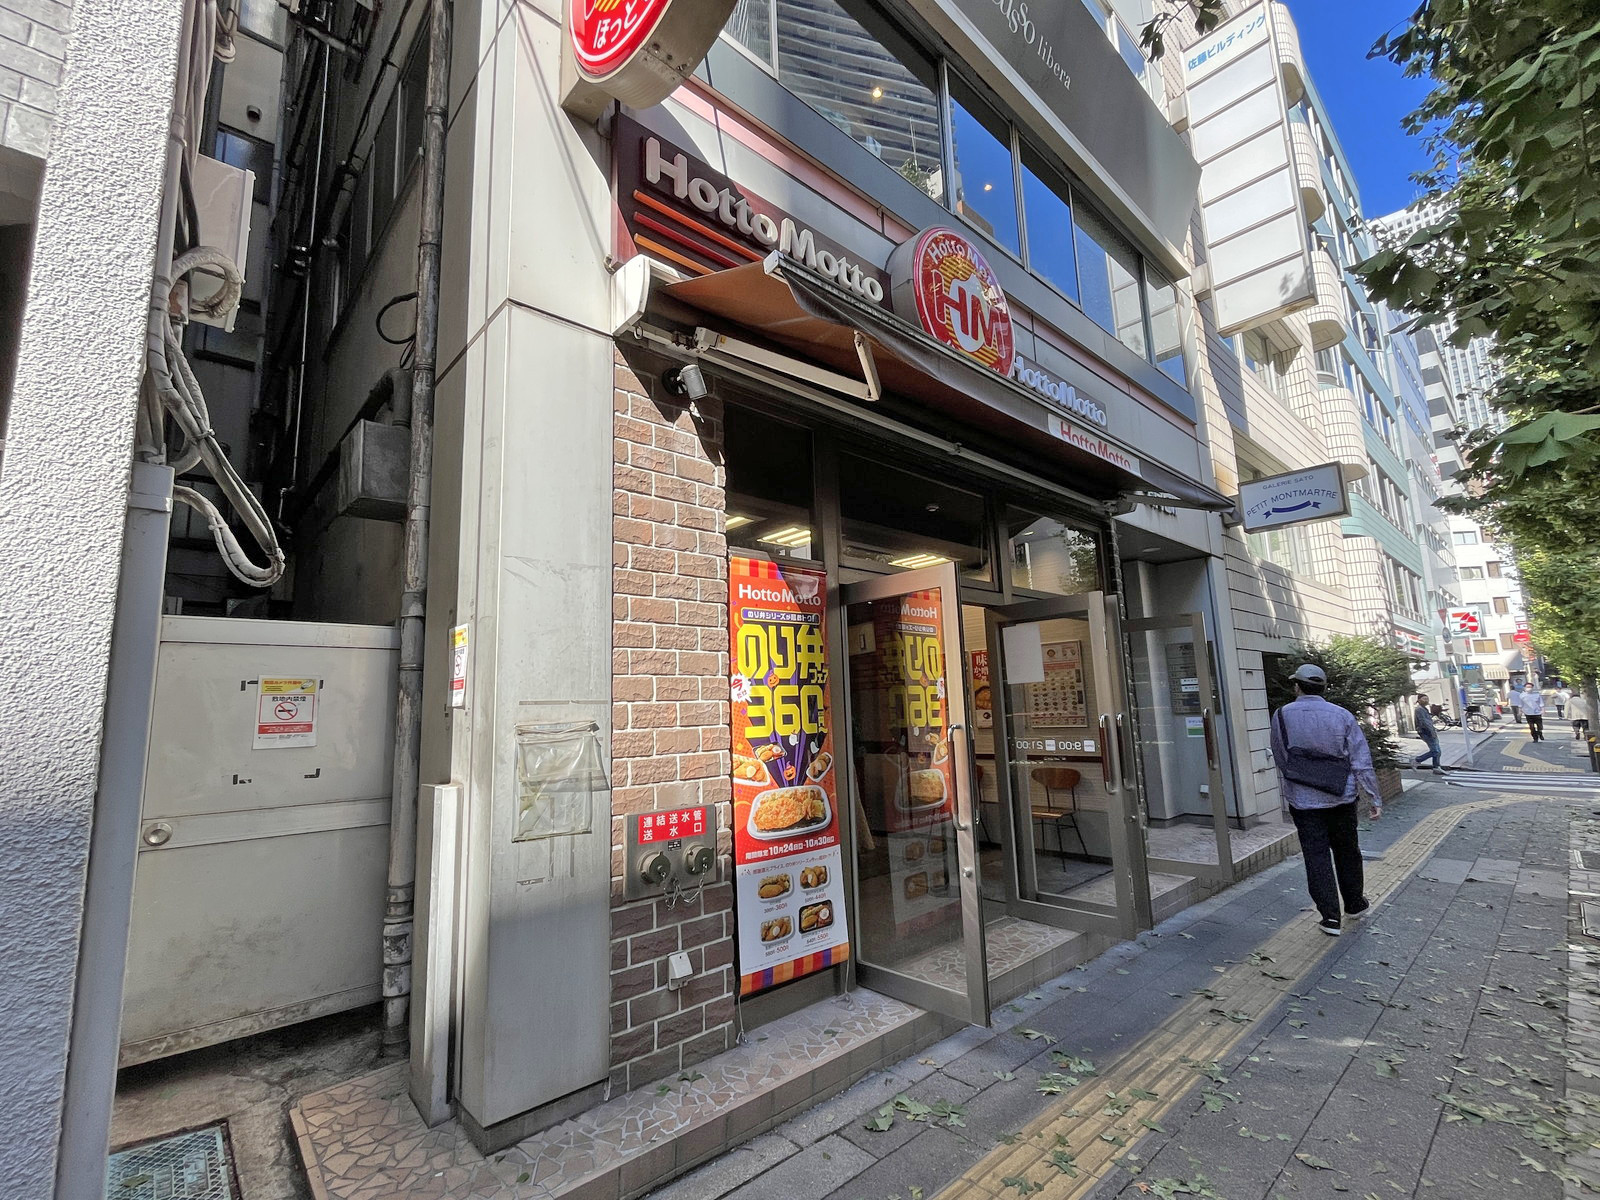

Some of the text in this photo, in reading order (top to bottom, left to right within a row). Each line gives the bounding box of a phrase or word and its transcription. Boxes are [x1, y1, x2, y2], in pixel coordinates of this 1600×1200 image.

[1037, 35, 1071, 91] libera
[645, 136, 884, 304] HottoMotto
[1013, 355, 1107, 428] HottoMotto
[1262, 475, 1315, 490] GALERIE SATO
[1246, 488, 1338, 517] PETIT MONTMARTRE
[738, 583, 822, 606] HottoMotto
[737, 624, 825, 679] のり弁
[643, 810, 703, 828] 連結送水管
[643, 822, 703, 841] 送水口
